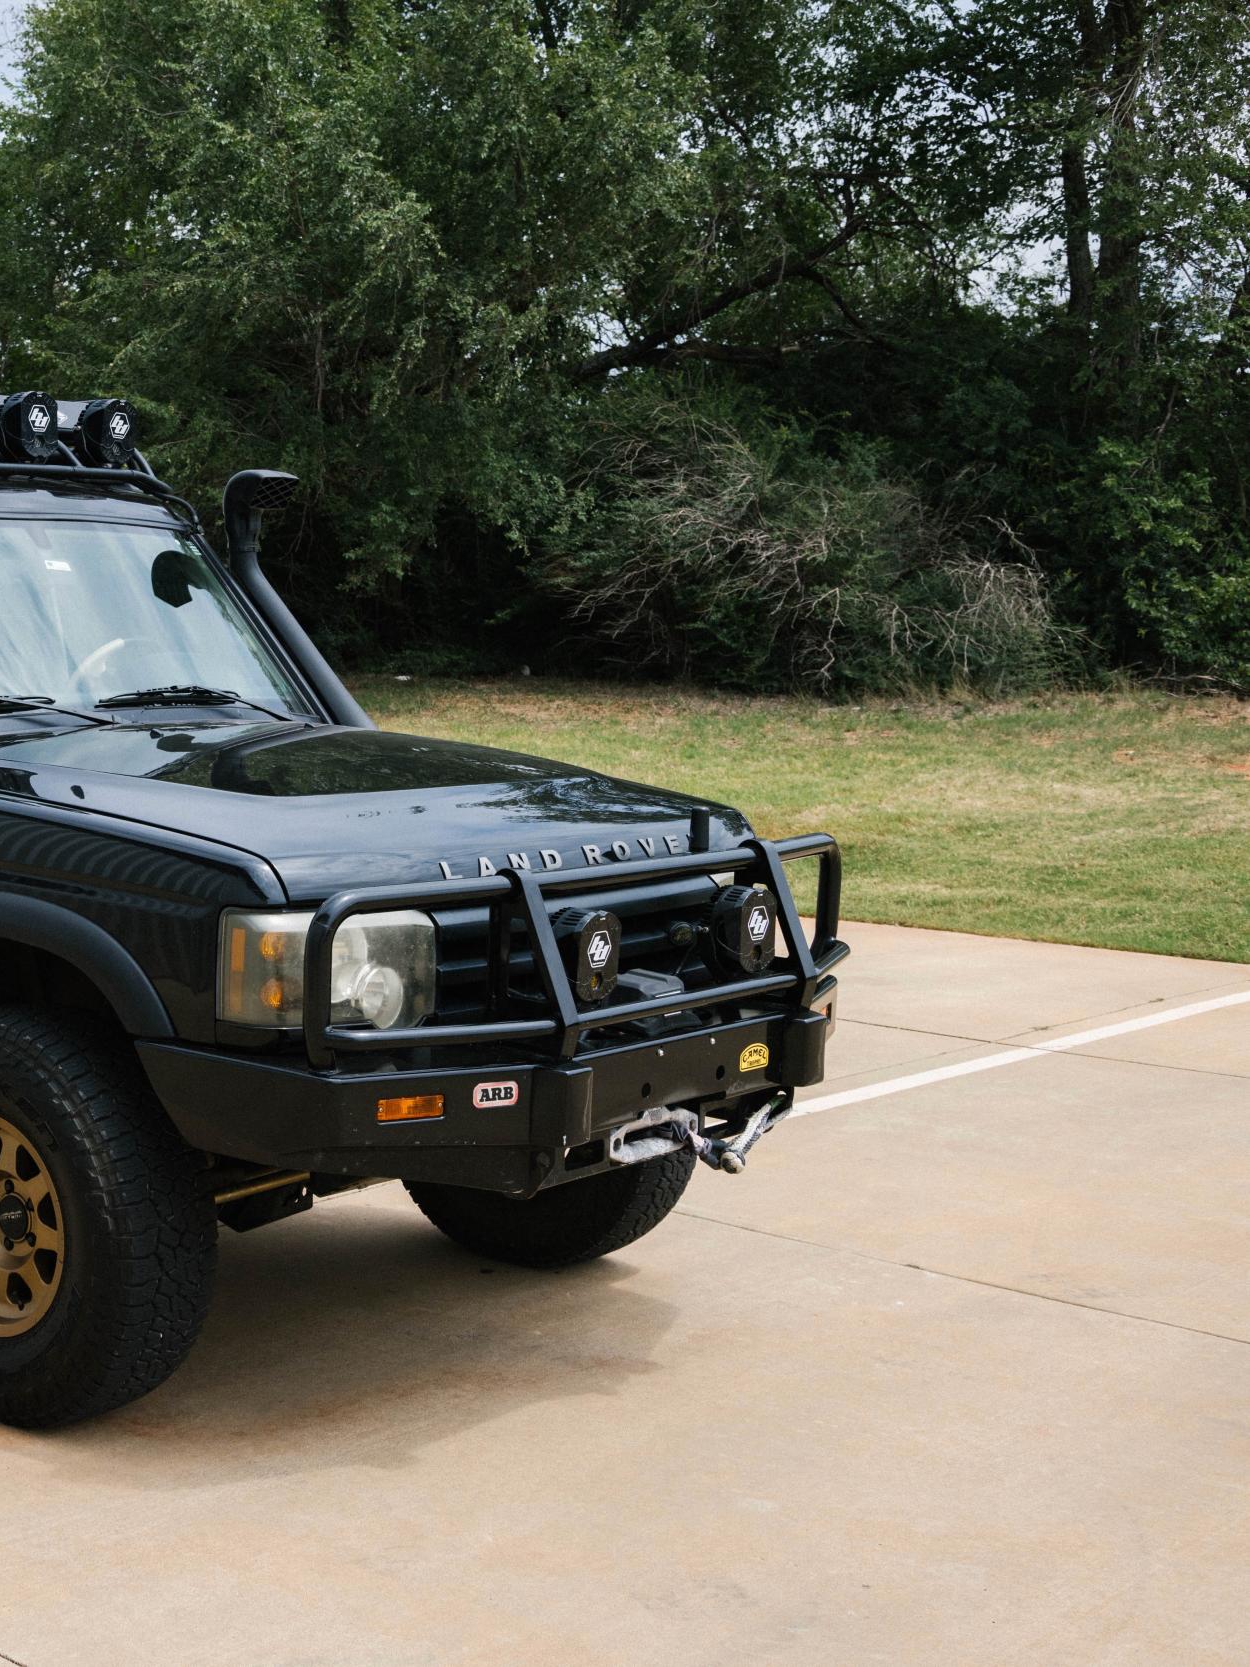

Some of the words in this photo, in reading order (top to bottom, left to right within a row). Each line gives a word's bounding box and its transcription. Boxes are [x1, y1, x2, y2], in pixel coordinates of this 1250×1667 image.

[439, 849, 563, 880] LAND
[581, 833, 692, 865] ROVE
[742, 1048, 767, 1063] CAMEL
[479, 1086, 514, 1102] ARB
